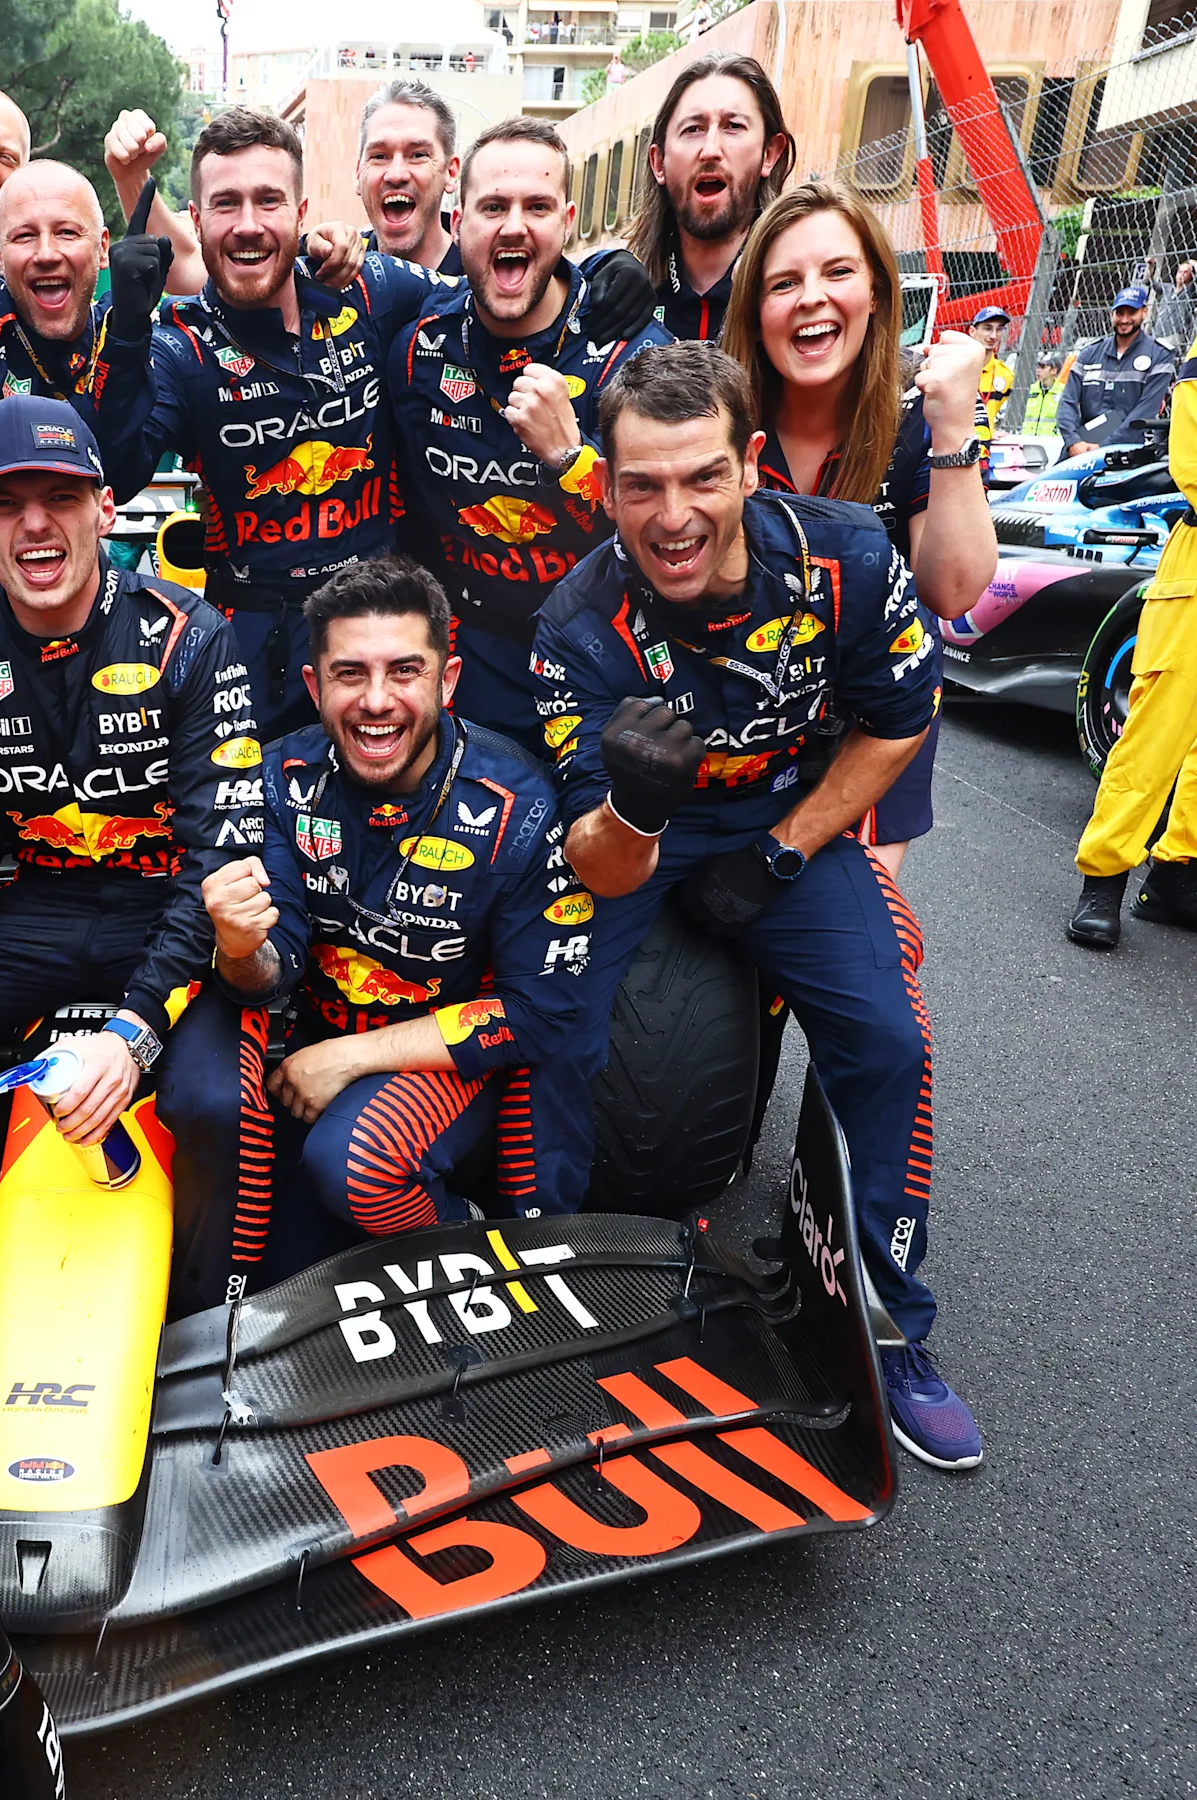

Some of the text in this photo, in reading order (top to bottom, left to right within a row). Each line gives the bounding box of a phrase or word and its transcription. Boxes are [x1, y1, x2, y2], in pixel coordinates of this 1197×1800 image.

[219, 383, 262, 403] Mobil
[219, 378, 380, 448] ORACLE
[430, 408, 467, 430] Mobil
[36, 425, 74, 436] ORACLE
[1034, 483, 1073, 504] Castrol
[234, 476, 382, 546] Red Bull
[100, 568, 119, 615] zoom
[40, 642, 80, 663] Red Bull
[110, 671, 152, 686] RAUCH
[99, 707, 163, 735] BYBIT
[99, 736, 170, 755] HONDA
[298, 816, 341, 838] TAG
[369, 815, 389, 827] Red
[418, 844, 464, 865] RAUCH
[791, 1158, 842, 1302] Claro
[334, 1230, 599, 1363] BYBIT
[5, 1382, 96, 1407] HRC
[304, 1356, 878, 1621] Bull
